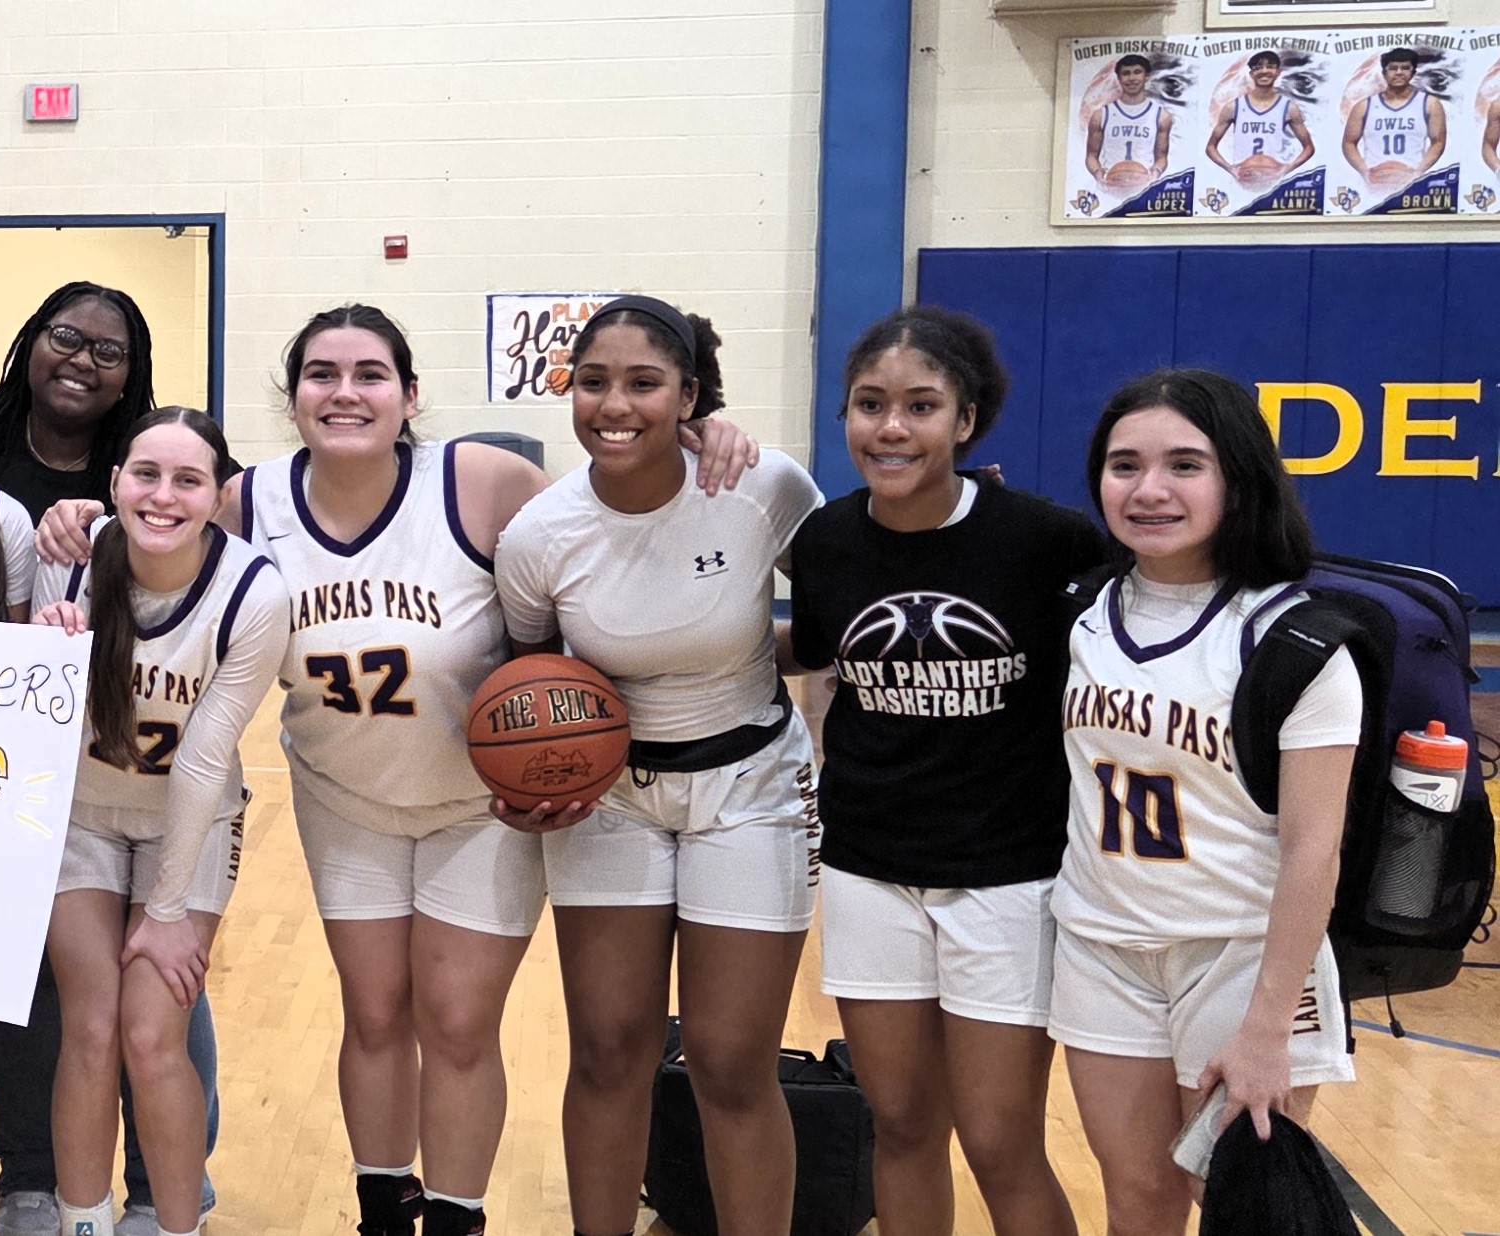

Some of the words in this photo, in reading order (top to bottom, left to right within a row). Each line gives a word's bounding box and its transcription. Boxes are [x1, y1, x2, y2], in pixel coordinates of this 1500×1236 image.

[1074, 42, 1112, 62] ODEM
[1115, 40, 1199, 59] BASKETBALL
[1203, 38, 1242, 58] ODEM
[1245, 36, 1331, 56] BASKETBALL
[1334, 36, 1374, 54] ODEM
[1377, 33, 1465, 51] BASKETBALL
[34, 87, 70, 118] EXIT
[1111, 125, 1150, 139] OWLS
[1241, 121, 1276, 135] OWLS
[1374, 117, 1415, 131] OWLS
[1125, 141, 1133, 161] 1
[1252, 137, 1264, 155] 2
[1382, 134, 1406, 155] 10
[1147, 199, 1186, 211] LOPEZ
[1271, 198, 1316, 210] ALANIZ
[1402, 195, 1451, 208] BROWN
[507, 310, 581, 358] Har
[1254, 379, 1500, 481] DE
[383, 580, 442, 629] PASS
[304, 645, 419, 718] 32
[834, 657, 886, 687] LADY
[891, 652, 1027, 689] PANTHERS
[164, 670, 200, 704] PAS
[487, 691, 539, 733] THE
[857, 686, 1006, 717] BASKETBALL
[1092, 758, 1190, 863] 10
[227, 843, 242, 881] LADY
[807, 847, 821, 887] LADY
